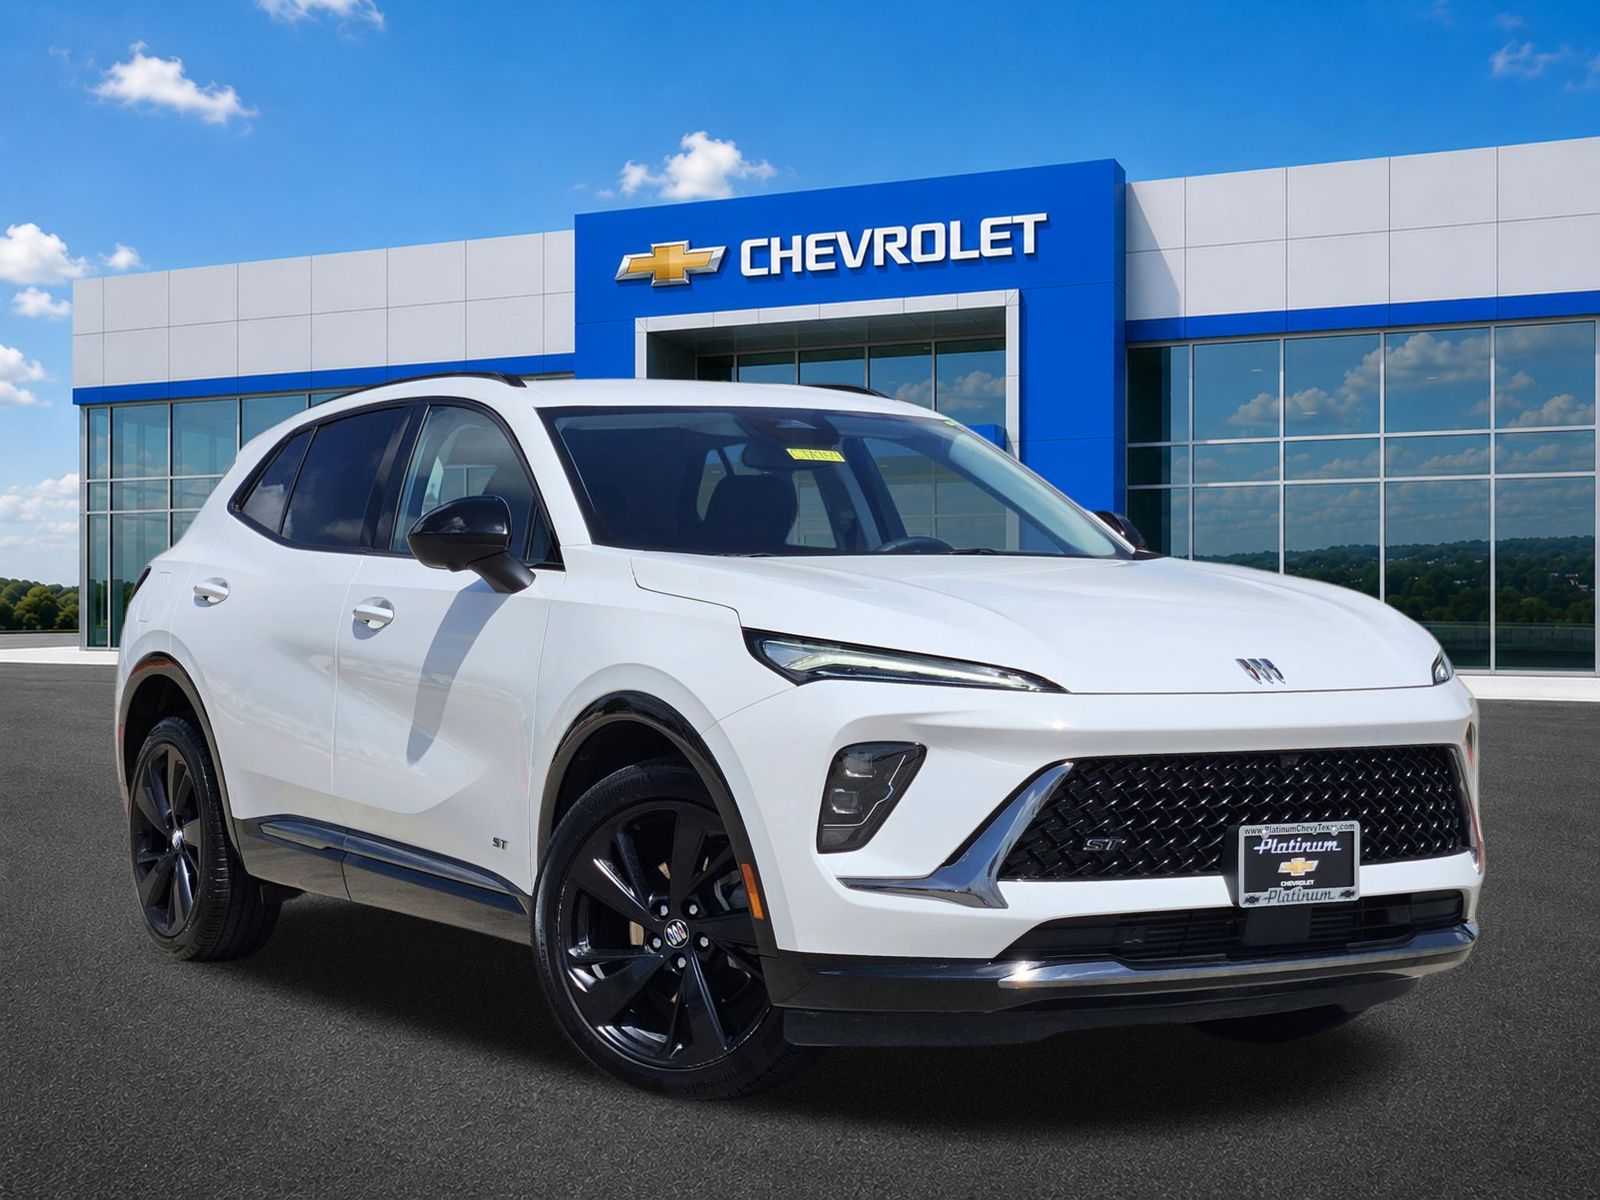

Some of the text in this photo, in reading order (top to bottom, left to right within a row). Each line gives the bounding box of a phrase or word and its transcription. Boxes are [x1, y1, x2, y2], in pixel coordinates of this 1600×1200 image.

[740, 212, 1047, 277] CHEVROLET
[1245, 824, 1355, 835] wwwPlatinumChevyTex.com
[492, 837, 509, 850] ST
[1083, 839, 1123, 851] ST
[1253, 837, 1342, 854] Platinum
[1280, 879, 1315, 887] CHEVROLET
[1263, 887, 1335, 904] Platinum
